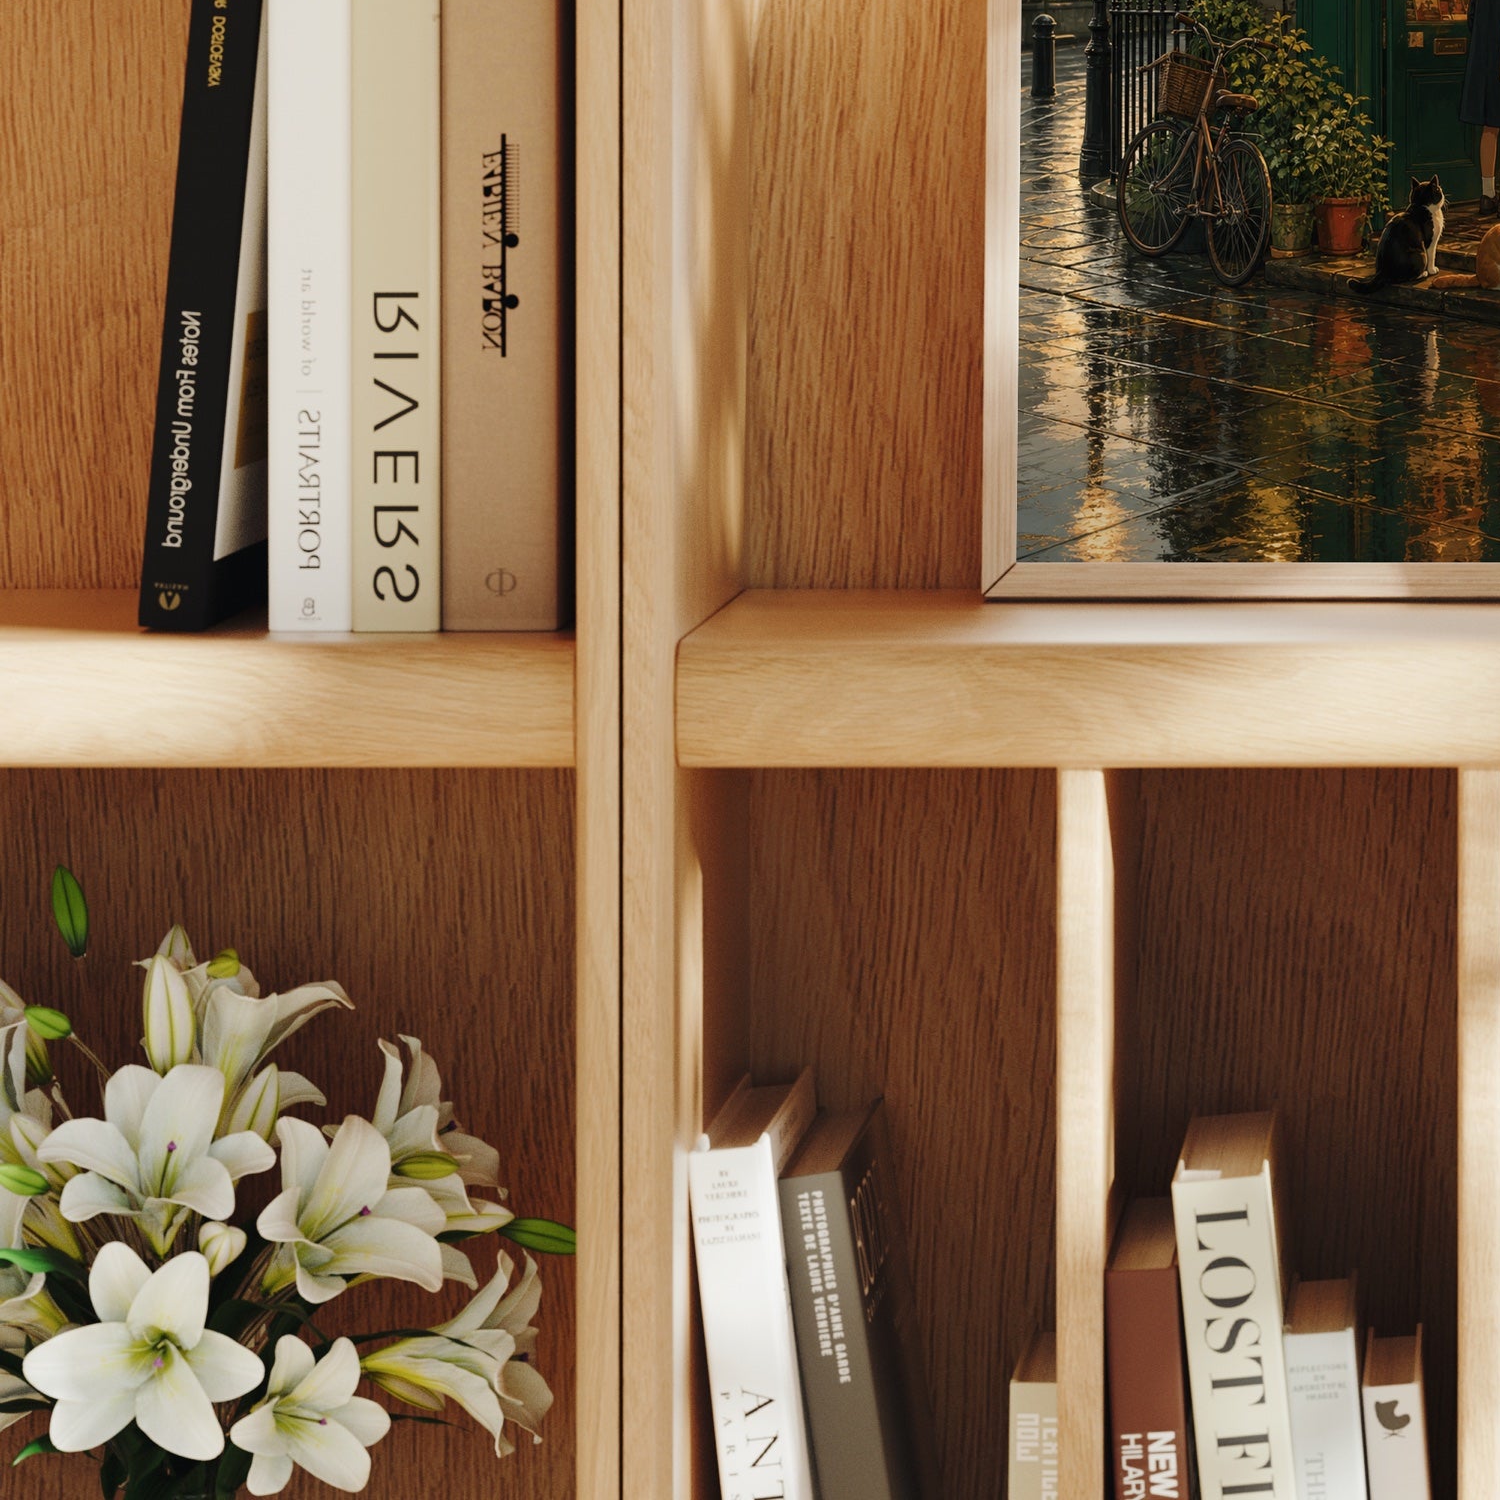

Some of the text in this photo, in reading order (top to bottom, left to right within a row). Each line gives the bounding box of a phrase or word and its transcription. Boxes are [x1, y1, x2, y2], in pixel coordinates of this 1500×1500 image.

[796, 1192, 813, 1231] TEXTE
[803, 1234, 817, 1250] DE
[806, 1254, 824, 1293] LAURE
[811, 1190, 838, 1290] PHOTOGRAPHIES
[835, 1342, 852, 1384] GARDE
[1194, 1202, 1267, 1407] LOST
[1146, 1430, 1179, 1499] NEW
